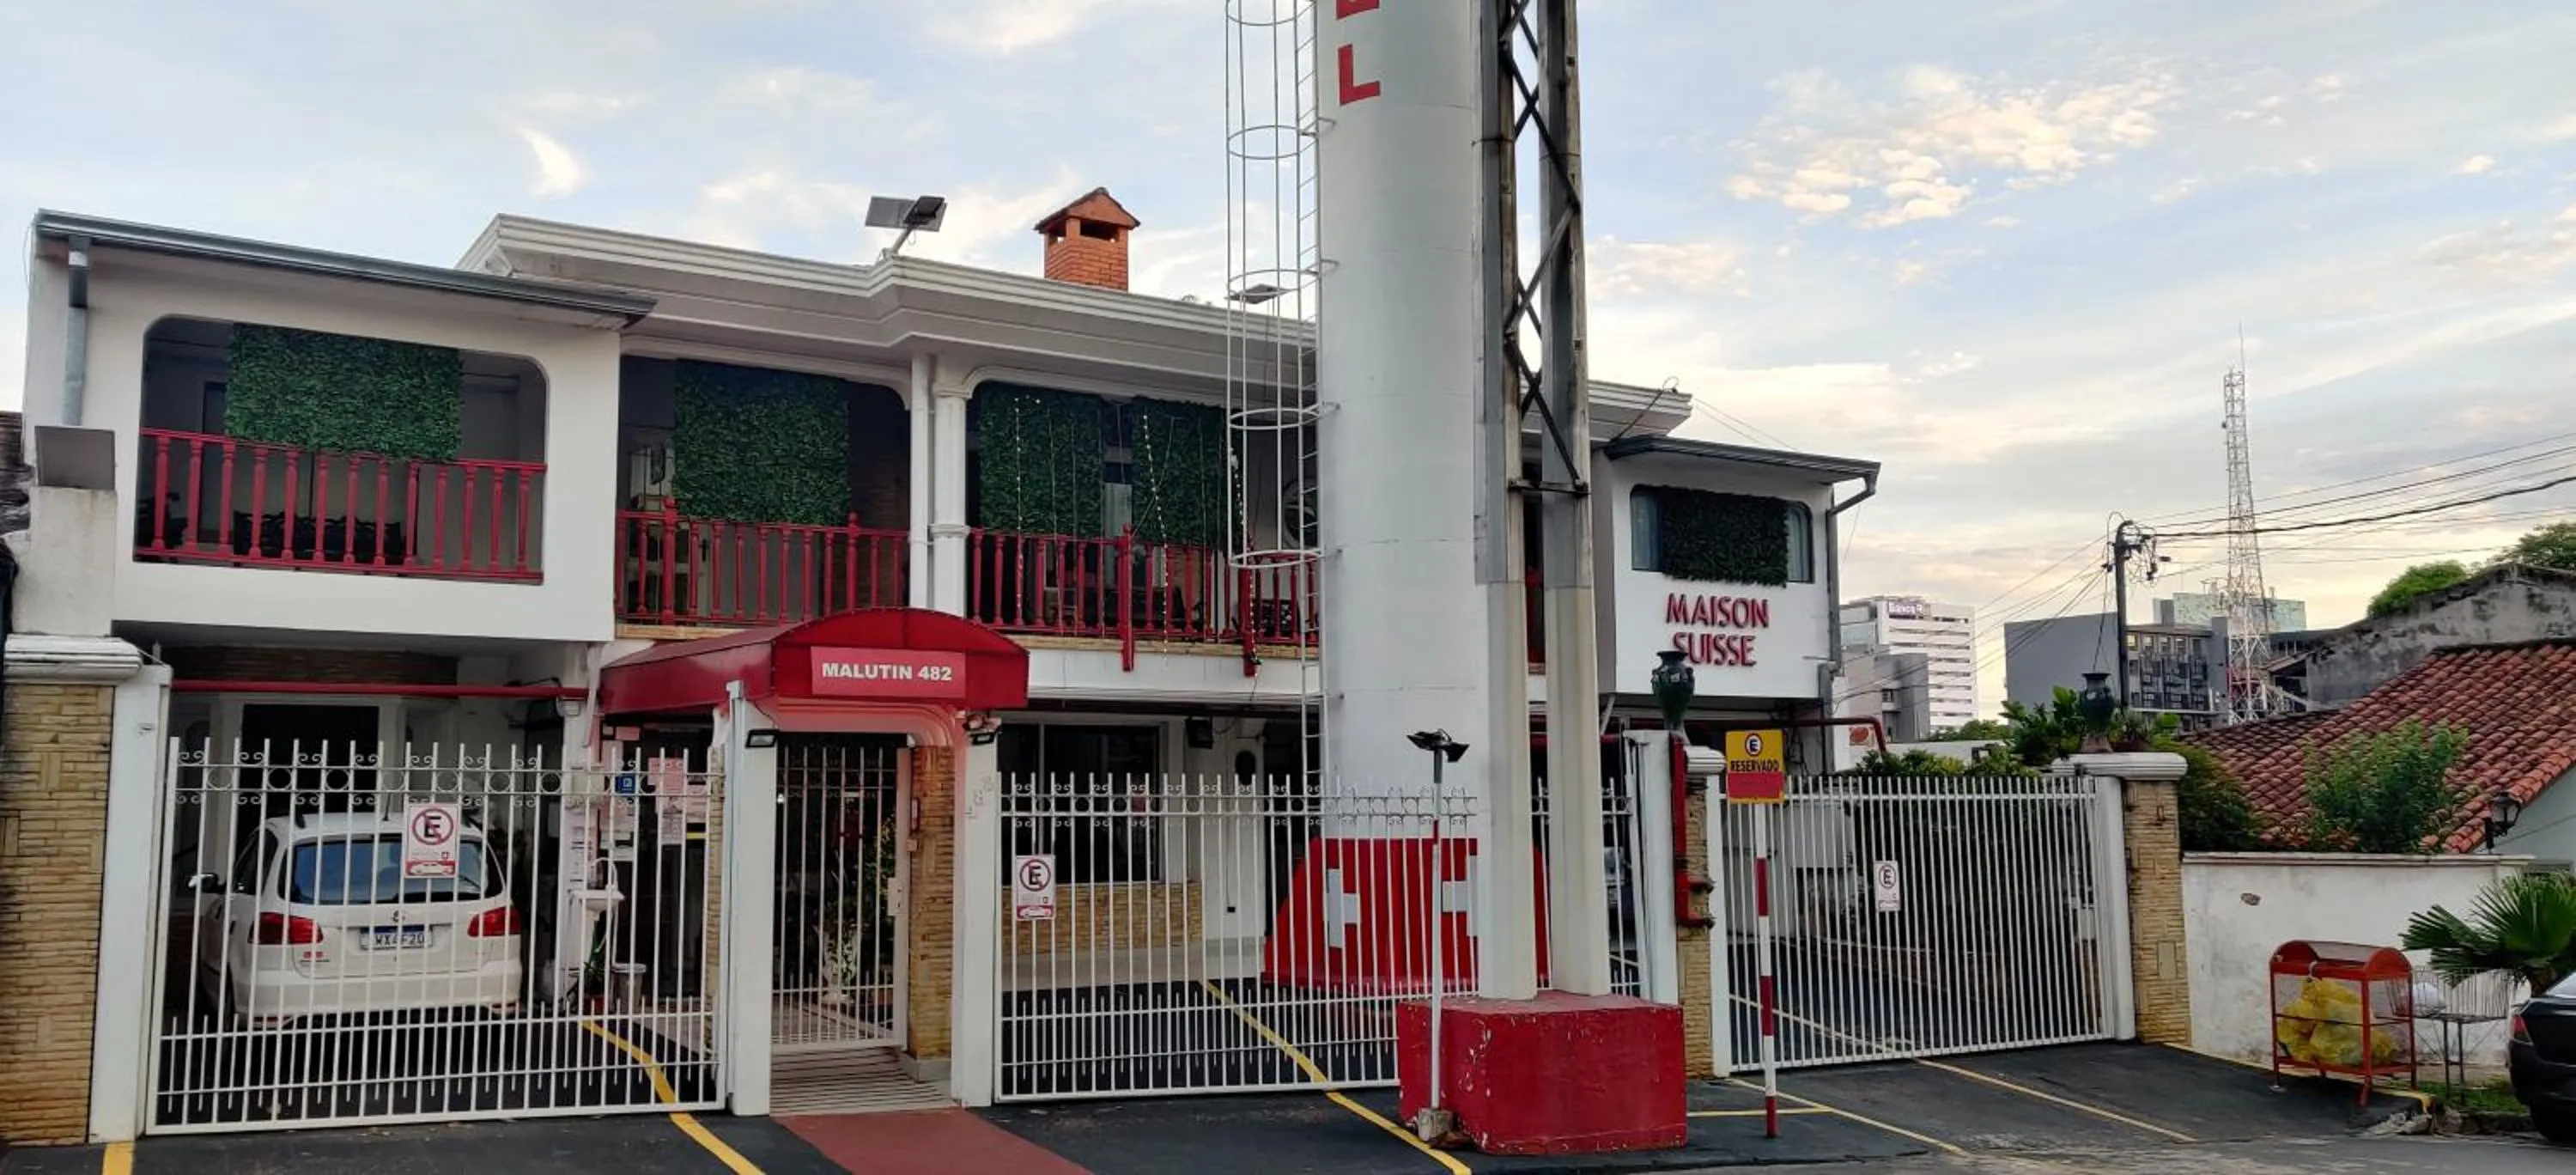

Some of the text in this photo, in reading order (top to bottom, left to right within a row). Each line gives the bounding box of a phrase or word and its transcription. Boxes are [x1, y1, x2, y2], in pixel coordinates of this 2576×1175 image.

[1666, 592, 1769, 629] MAISON
[1673, 632, 1757, 667] SUISSE
[822, 662, 952, 681] MALUTIN 482
[1731, 759, 1780, 772] RESERVADO
